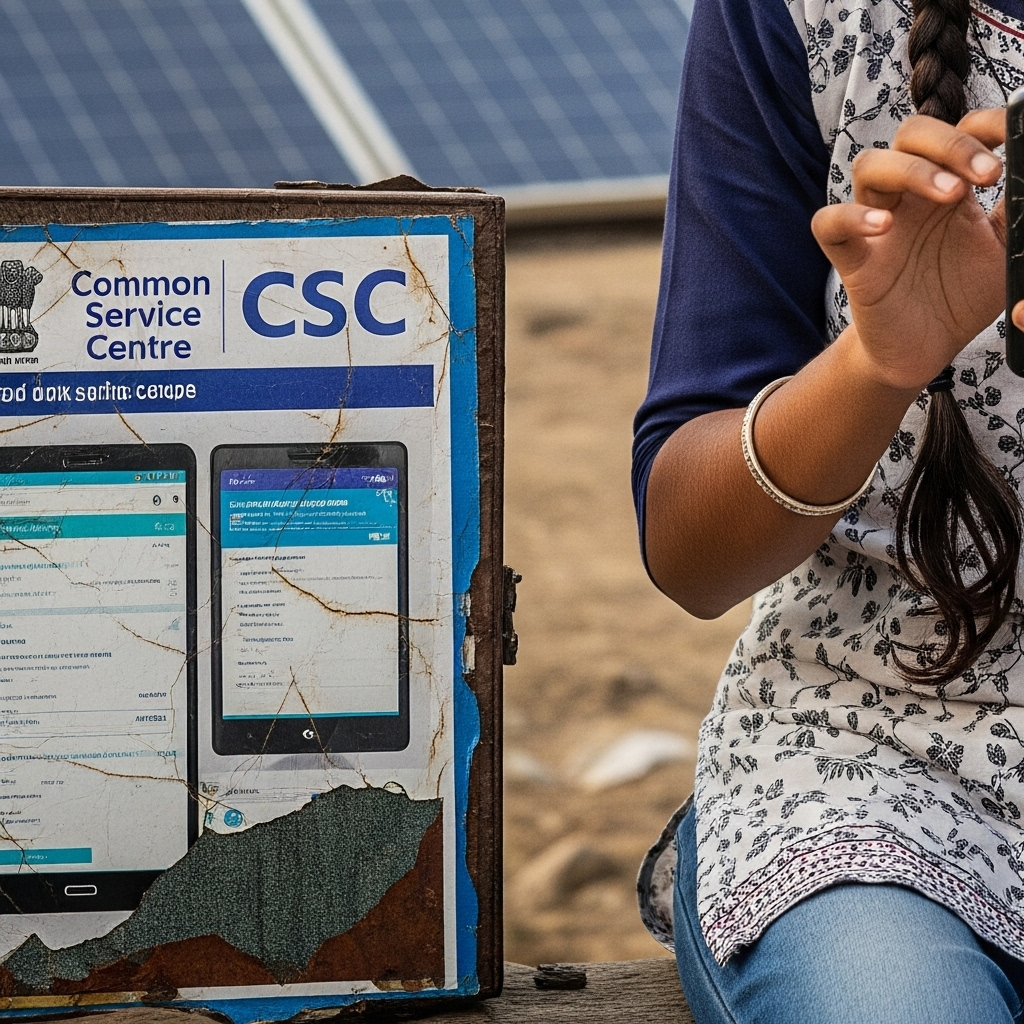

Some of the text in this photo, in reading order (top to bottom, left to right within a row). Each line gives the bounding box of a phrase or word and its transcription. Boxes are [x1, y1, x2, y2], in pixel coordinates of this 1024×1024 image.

[71, 269, 211, 297] Common
[86, 300, 201, 328] Service
[241, 269, 407, 339] CSC
[86, 334, 192, 361] Centre
